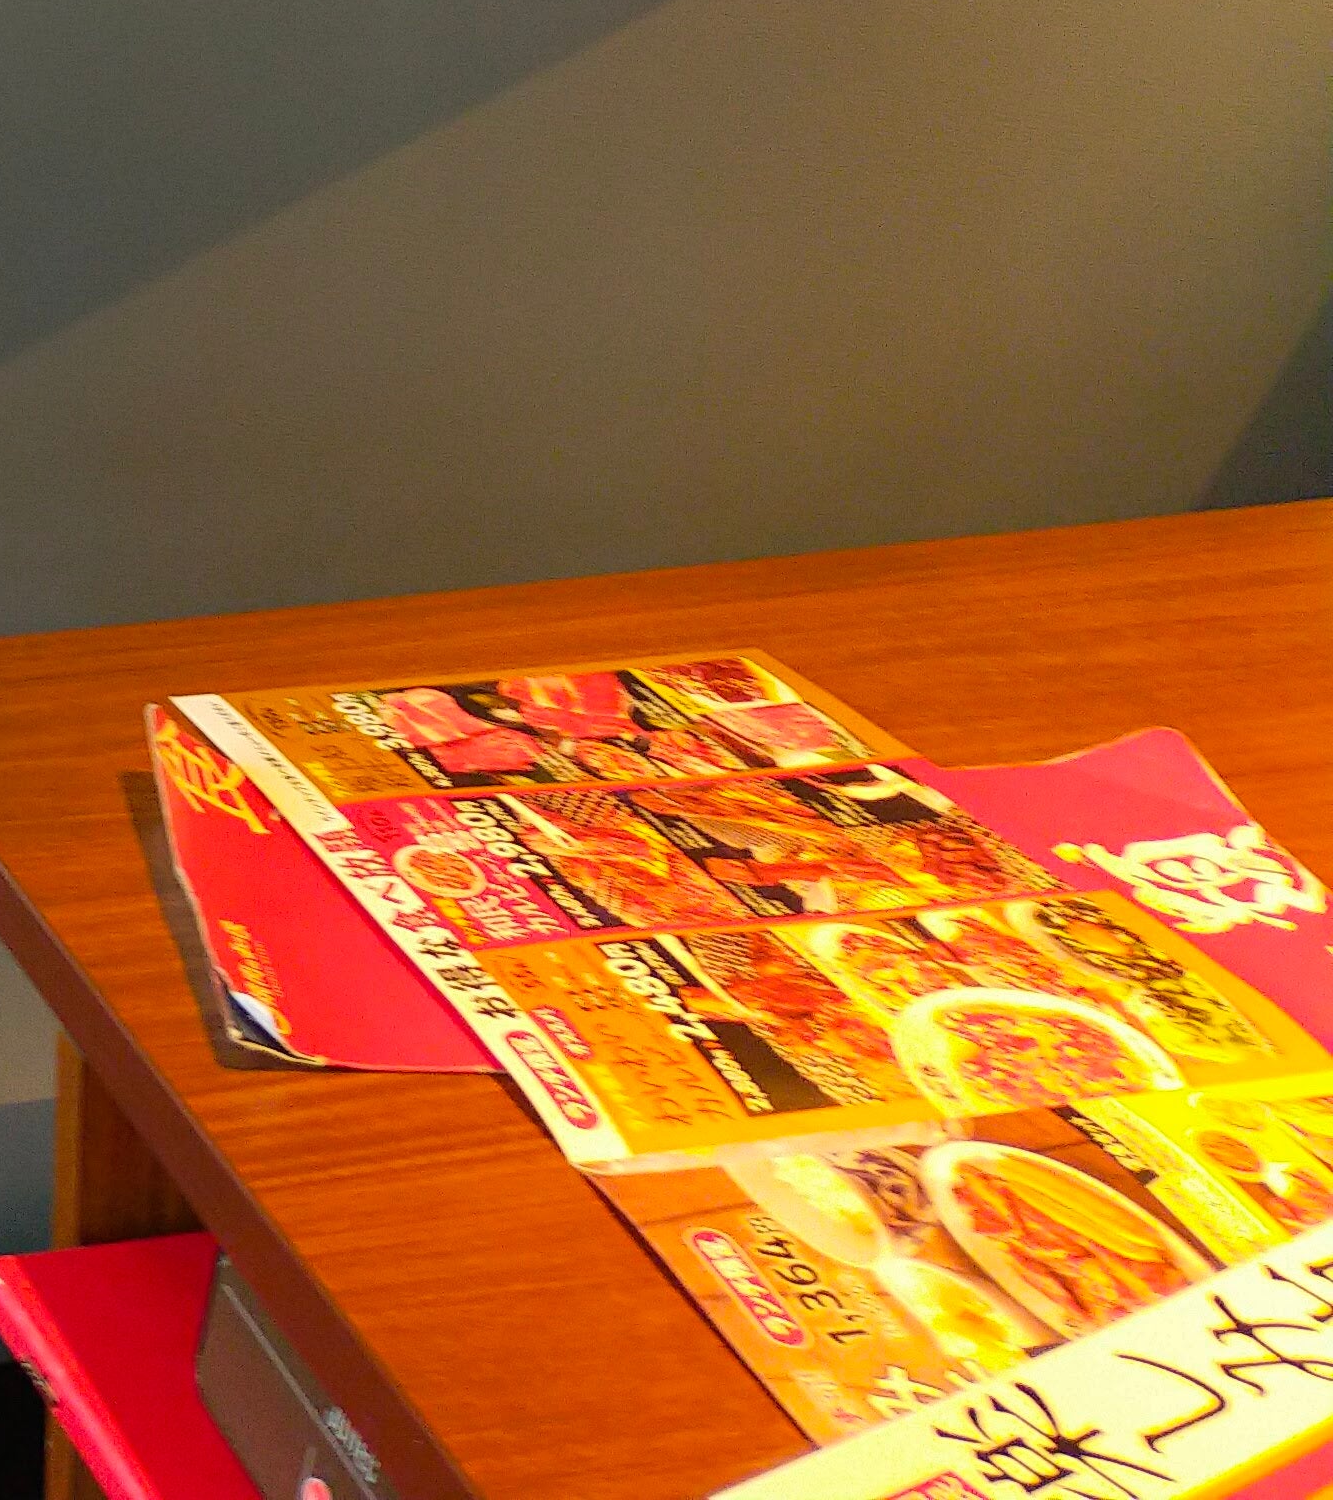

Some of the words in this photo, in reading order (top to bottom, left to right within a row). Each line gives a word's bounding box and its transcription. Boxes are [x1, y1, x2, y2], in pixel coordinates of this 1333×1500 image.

[330, 692, 416, 751] 3,980円
[450, 800, 555, 879] 2,980円
[314, 830, 523, 1020] お得な食べ放題
[595, 942, 721, 1043] 2,480円
[747, 1215, 873, 1345] 1,364円
